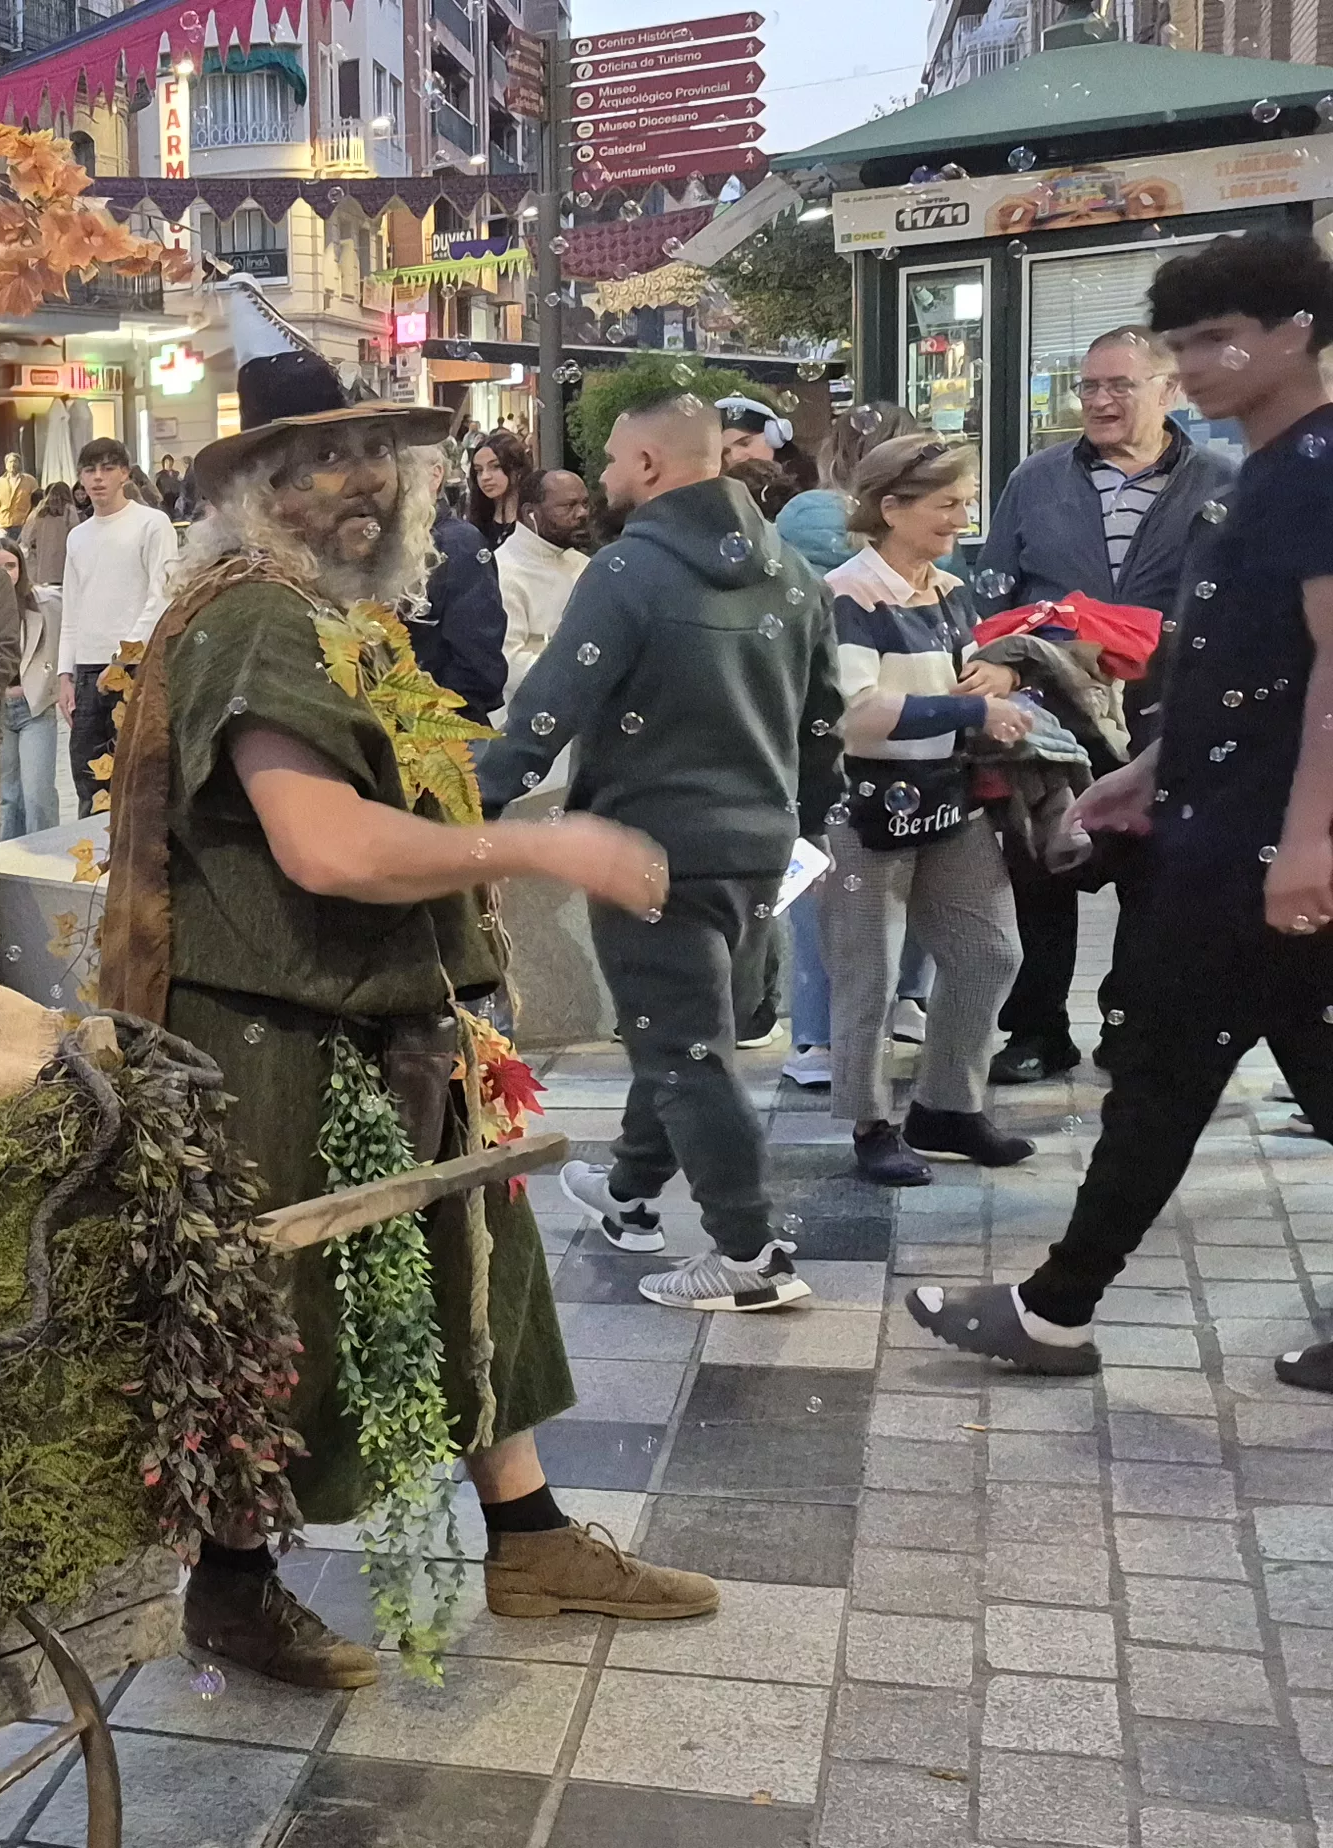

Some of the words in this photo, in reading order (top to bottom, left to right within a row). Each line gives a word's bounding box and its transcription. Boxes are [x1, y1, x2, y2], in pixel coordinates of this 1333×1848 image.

[598, 36, 635, 50] Centro
[598, 60, 637, 74] Oficina
[640, 58, 654, 69] de
[657, 51, 702, 65] Turismo
[598, 84, 636, 97] Museo
[598, 91, 673, 109] Arqueológico
[675, 81, 730, 97] Provincial
[598, 119, 636, 133] Museo
[639, 112, 698, 128] Diocesano
[599, 142, 646, 156] Catedral
[600, 164, 676, 182] Ayuntamiento
[899, 204, 966, 229] 11/11
[853, 231, 885, 241] ONCE
[888, 804, 961, 836] Berlin
